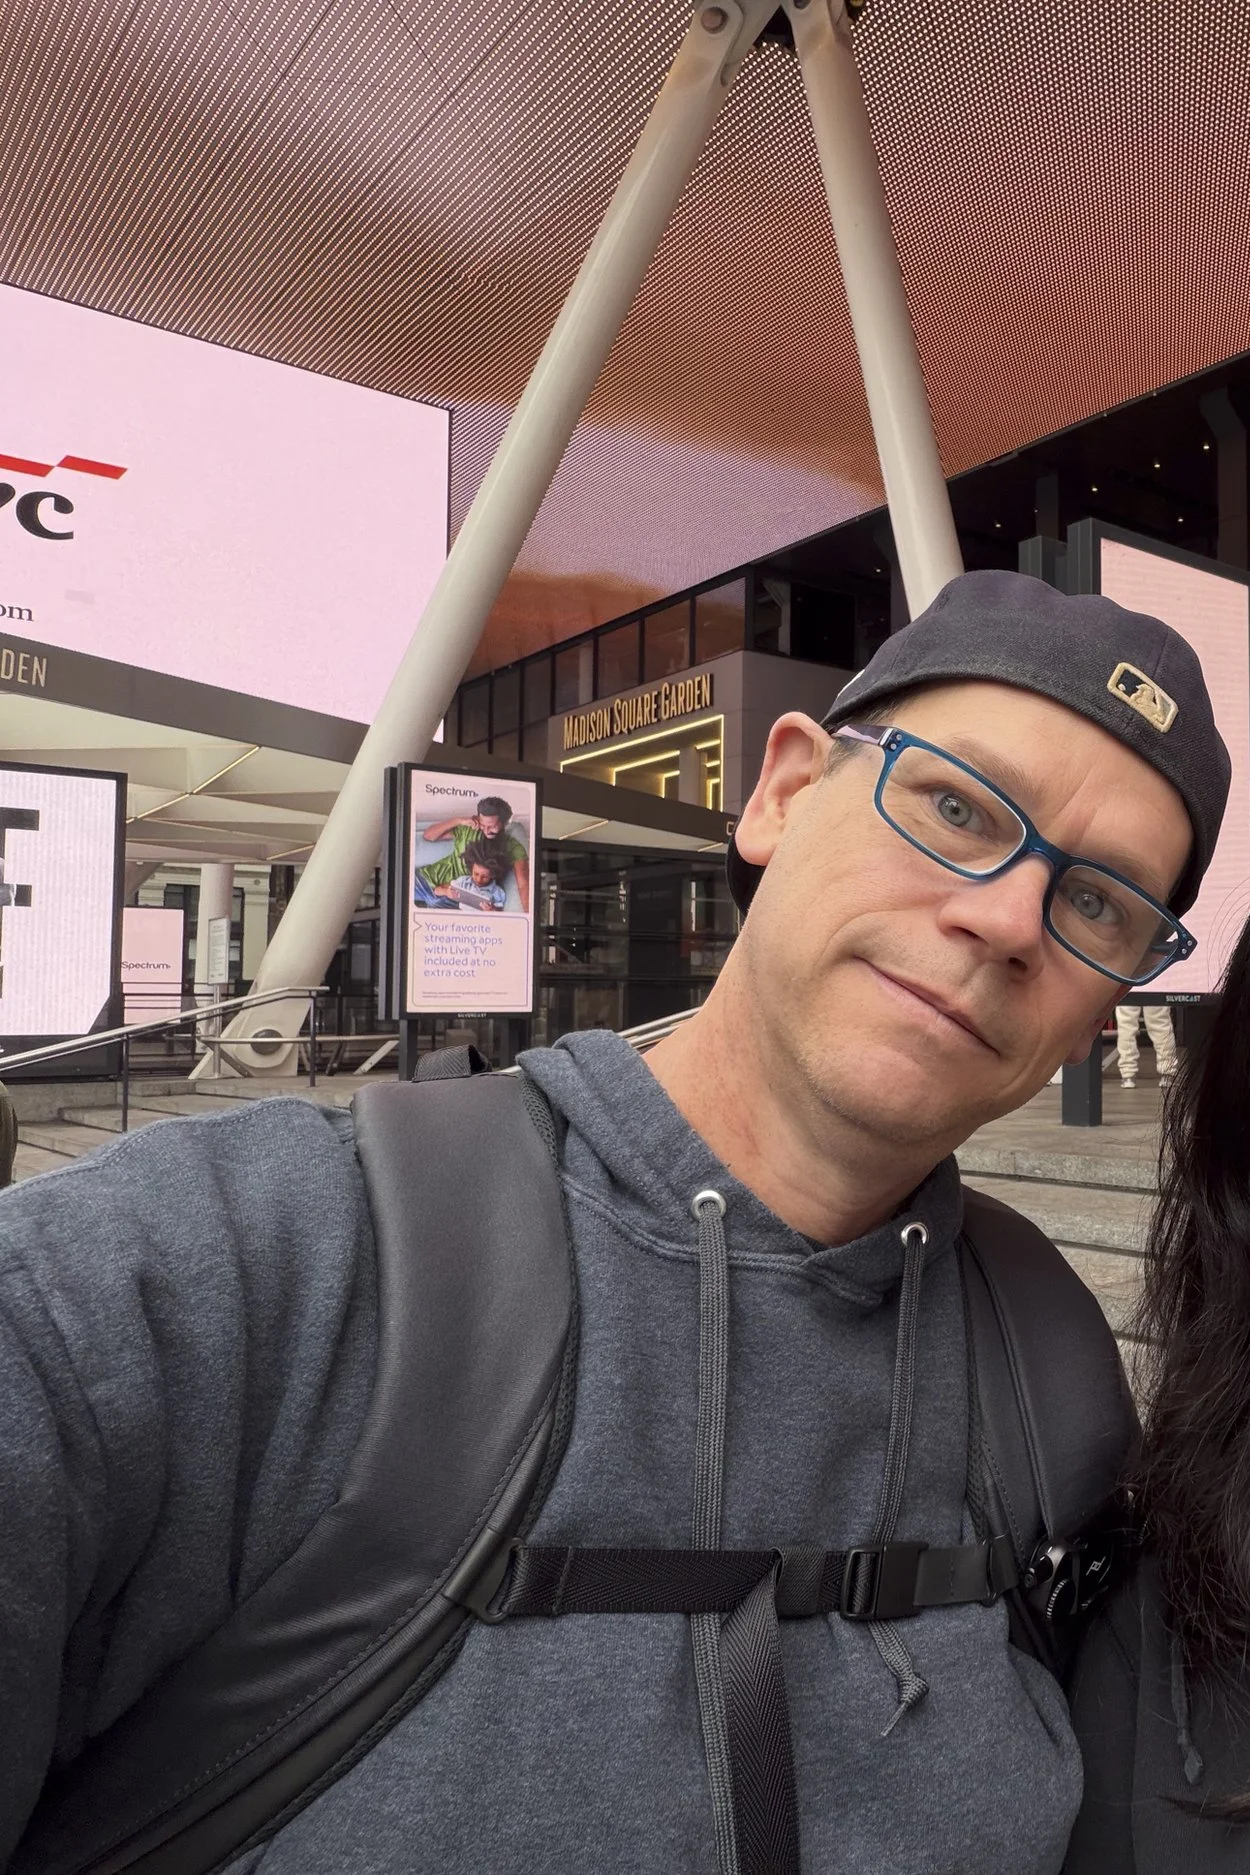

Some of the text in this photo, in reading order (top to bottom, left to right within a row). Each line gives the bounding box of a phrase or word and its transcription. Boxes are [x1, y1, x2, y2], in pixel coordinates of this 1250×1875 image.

[563, 673, 712, 750] MADISON SQUARE GARDEN
[425, 783, 477, 798] Spectrum
[424, 922, 491, 933] Your favorite
[424, 934, 503, 946] streaming apps
[424, 945, 487, 955] with Live TV
[121, 961, 169, 971] Spectrum
[424, 956, 468, 966] included
[423, 969, 476, 978] extra cost
